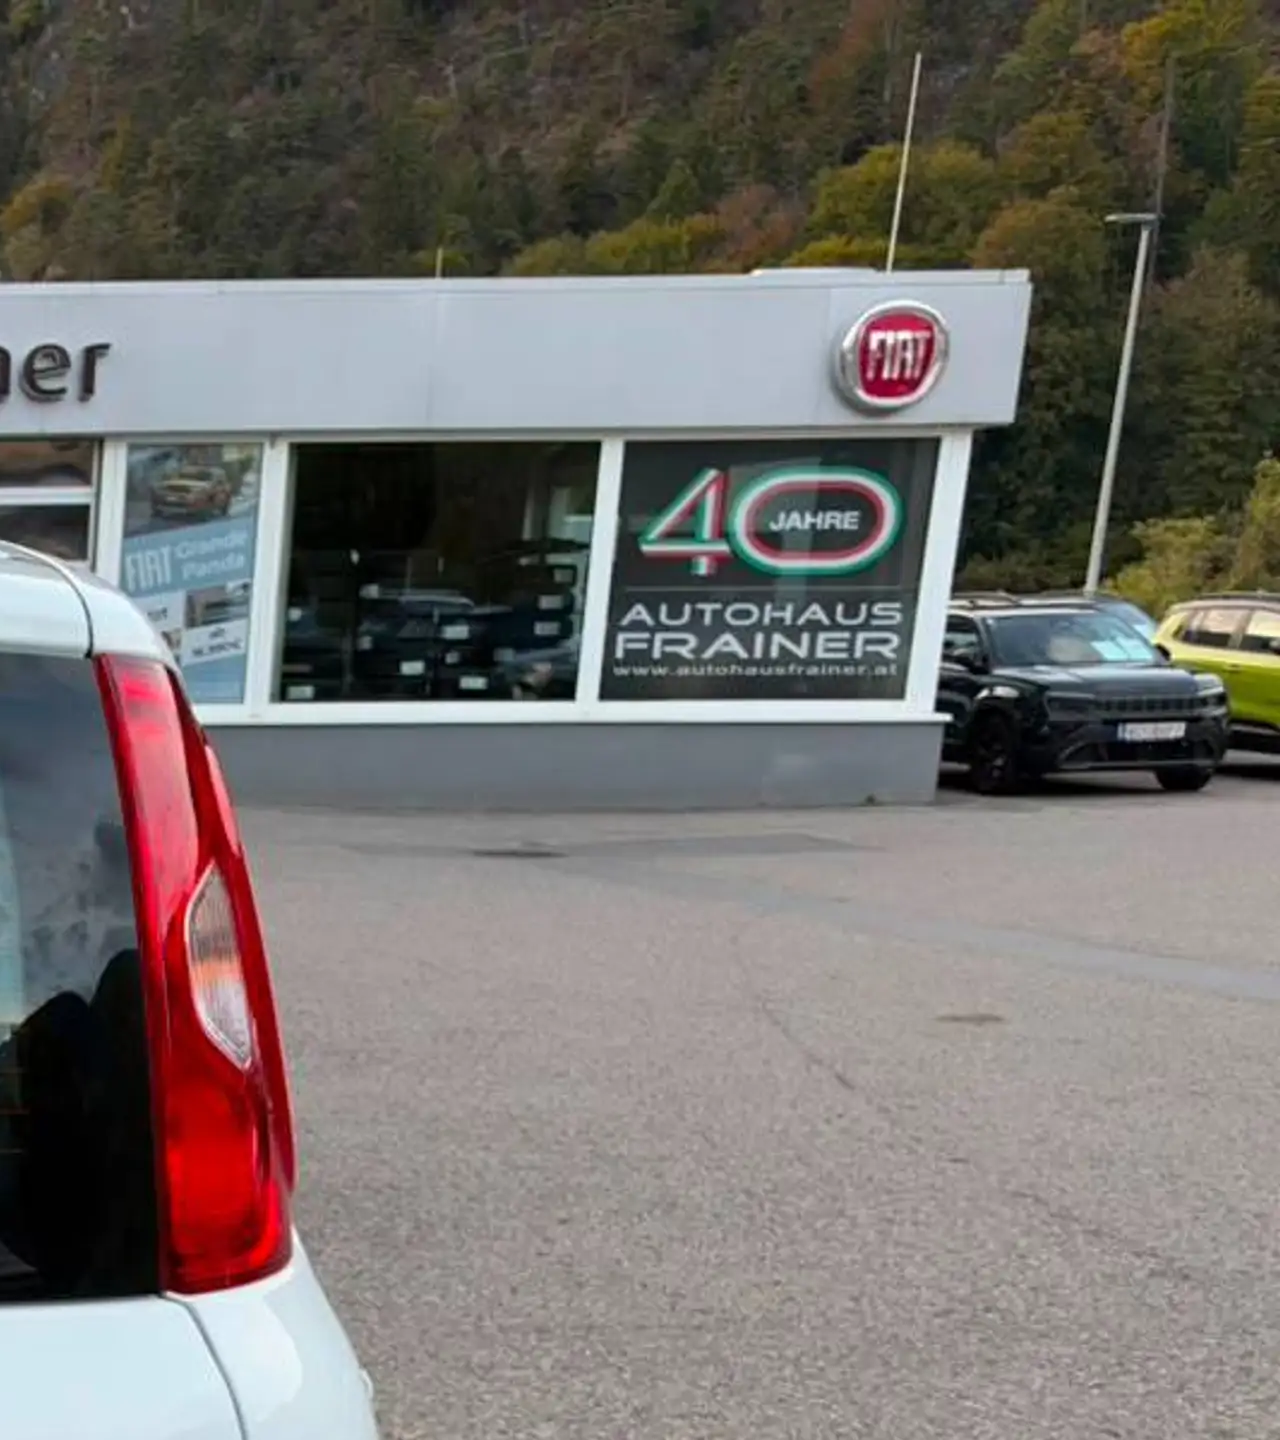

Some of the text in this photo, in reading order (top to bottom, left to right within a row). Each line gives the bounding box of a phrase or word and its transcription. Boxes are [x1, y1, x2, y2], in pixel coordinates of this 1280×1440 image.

[866, 330, 931, 380] FIAT
[639, 466, 906, 576] 40
[769, 510, 860, 532] JAHRE
[125, 544, 173, 592] FIAT
[620, 602, 904, 627] AUTOHAUS
[615, 631, 902, 660] FRAINER
[613, 662, 898, 677] www.autohausfrainer.at
